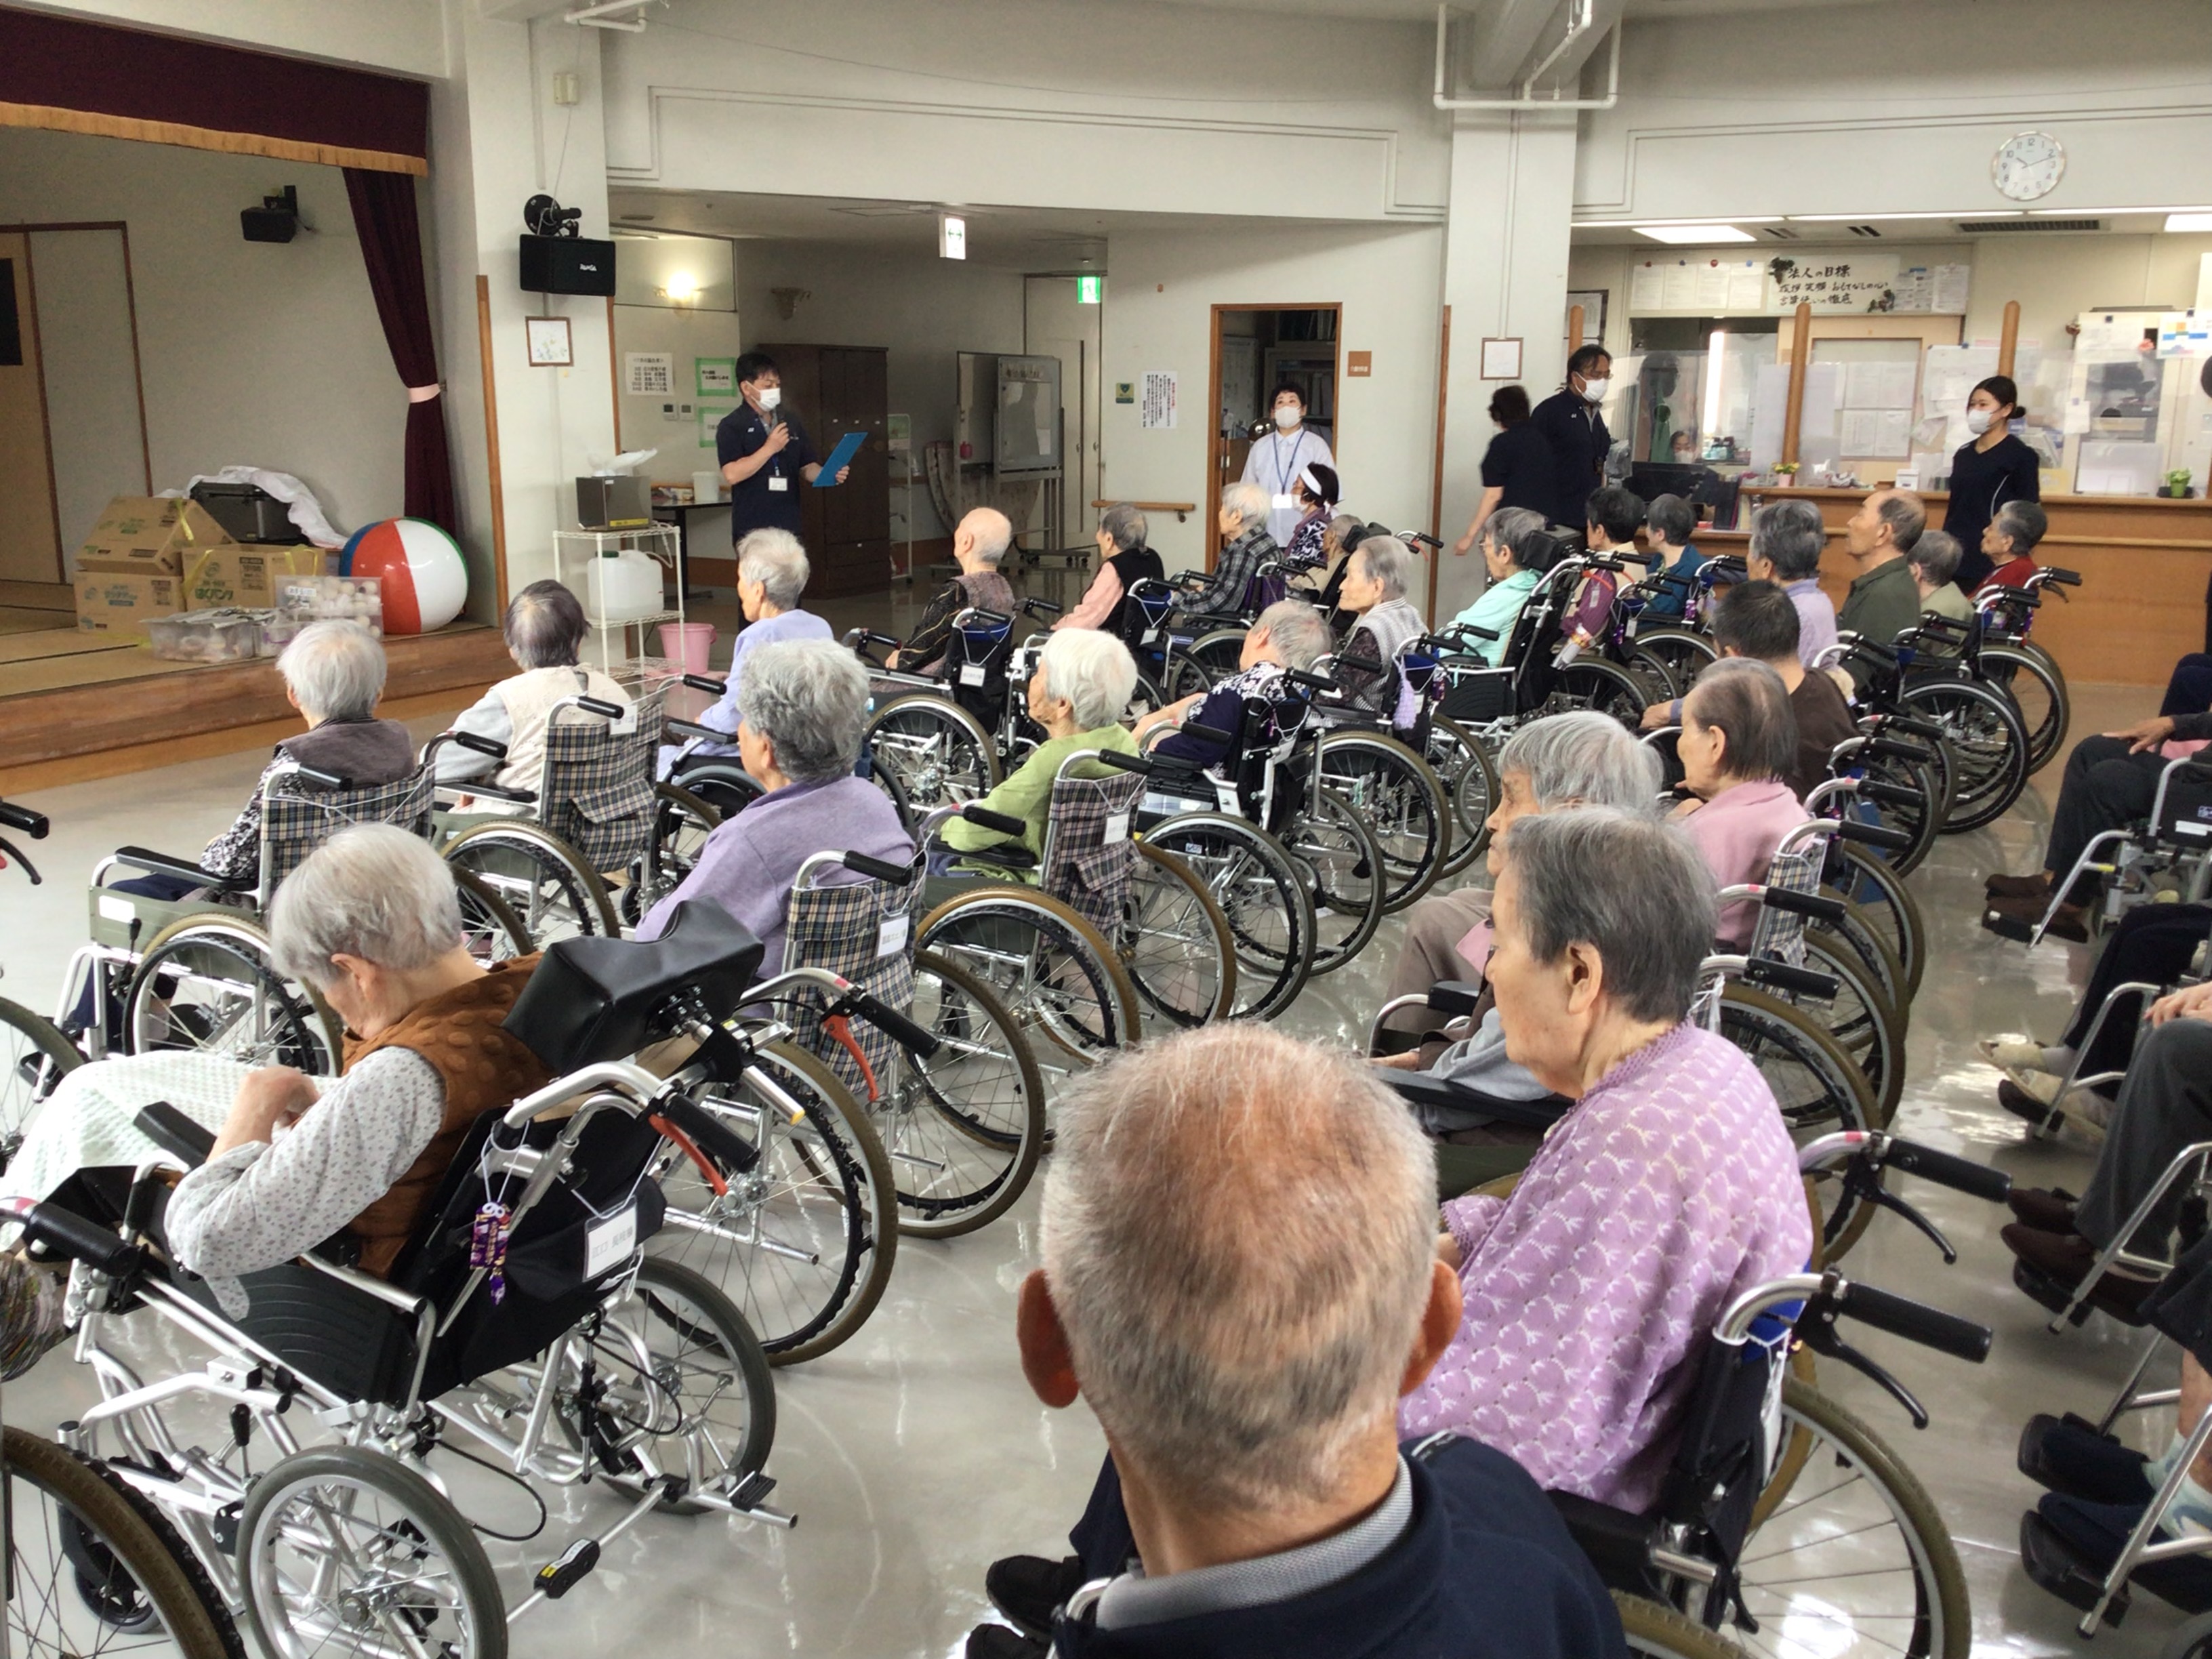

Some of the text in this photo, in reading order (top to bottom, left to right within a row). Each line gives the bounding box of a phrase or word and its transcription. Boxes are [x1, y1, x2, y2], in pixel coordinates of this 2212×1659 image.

[2016, 141, 2022, 150] 11
[2028, 138, 2035, 146] 12
[2006, 150, 2014, 158] 10
[2048, 148, 2054, 157] 2
[2001, 162, 2008, 170] 9
[2051, 160, 2056, 169] 3
[2003, 174, 2009, 182] 8
[2035, 181, 2042, 189] 5
[2023, 186, 2030, 194] 6
[1788, 264, 1851, 279] 法人の目標
